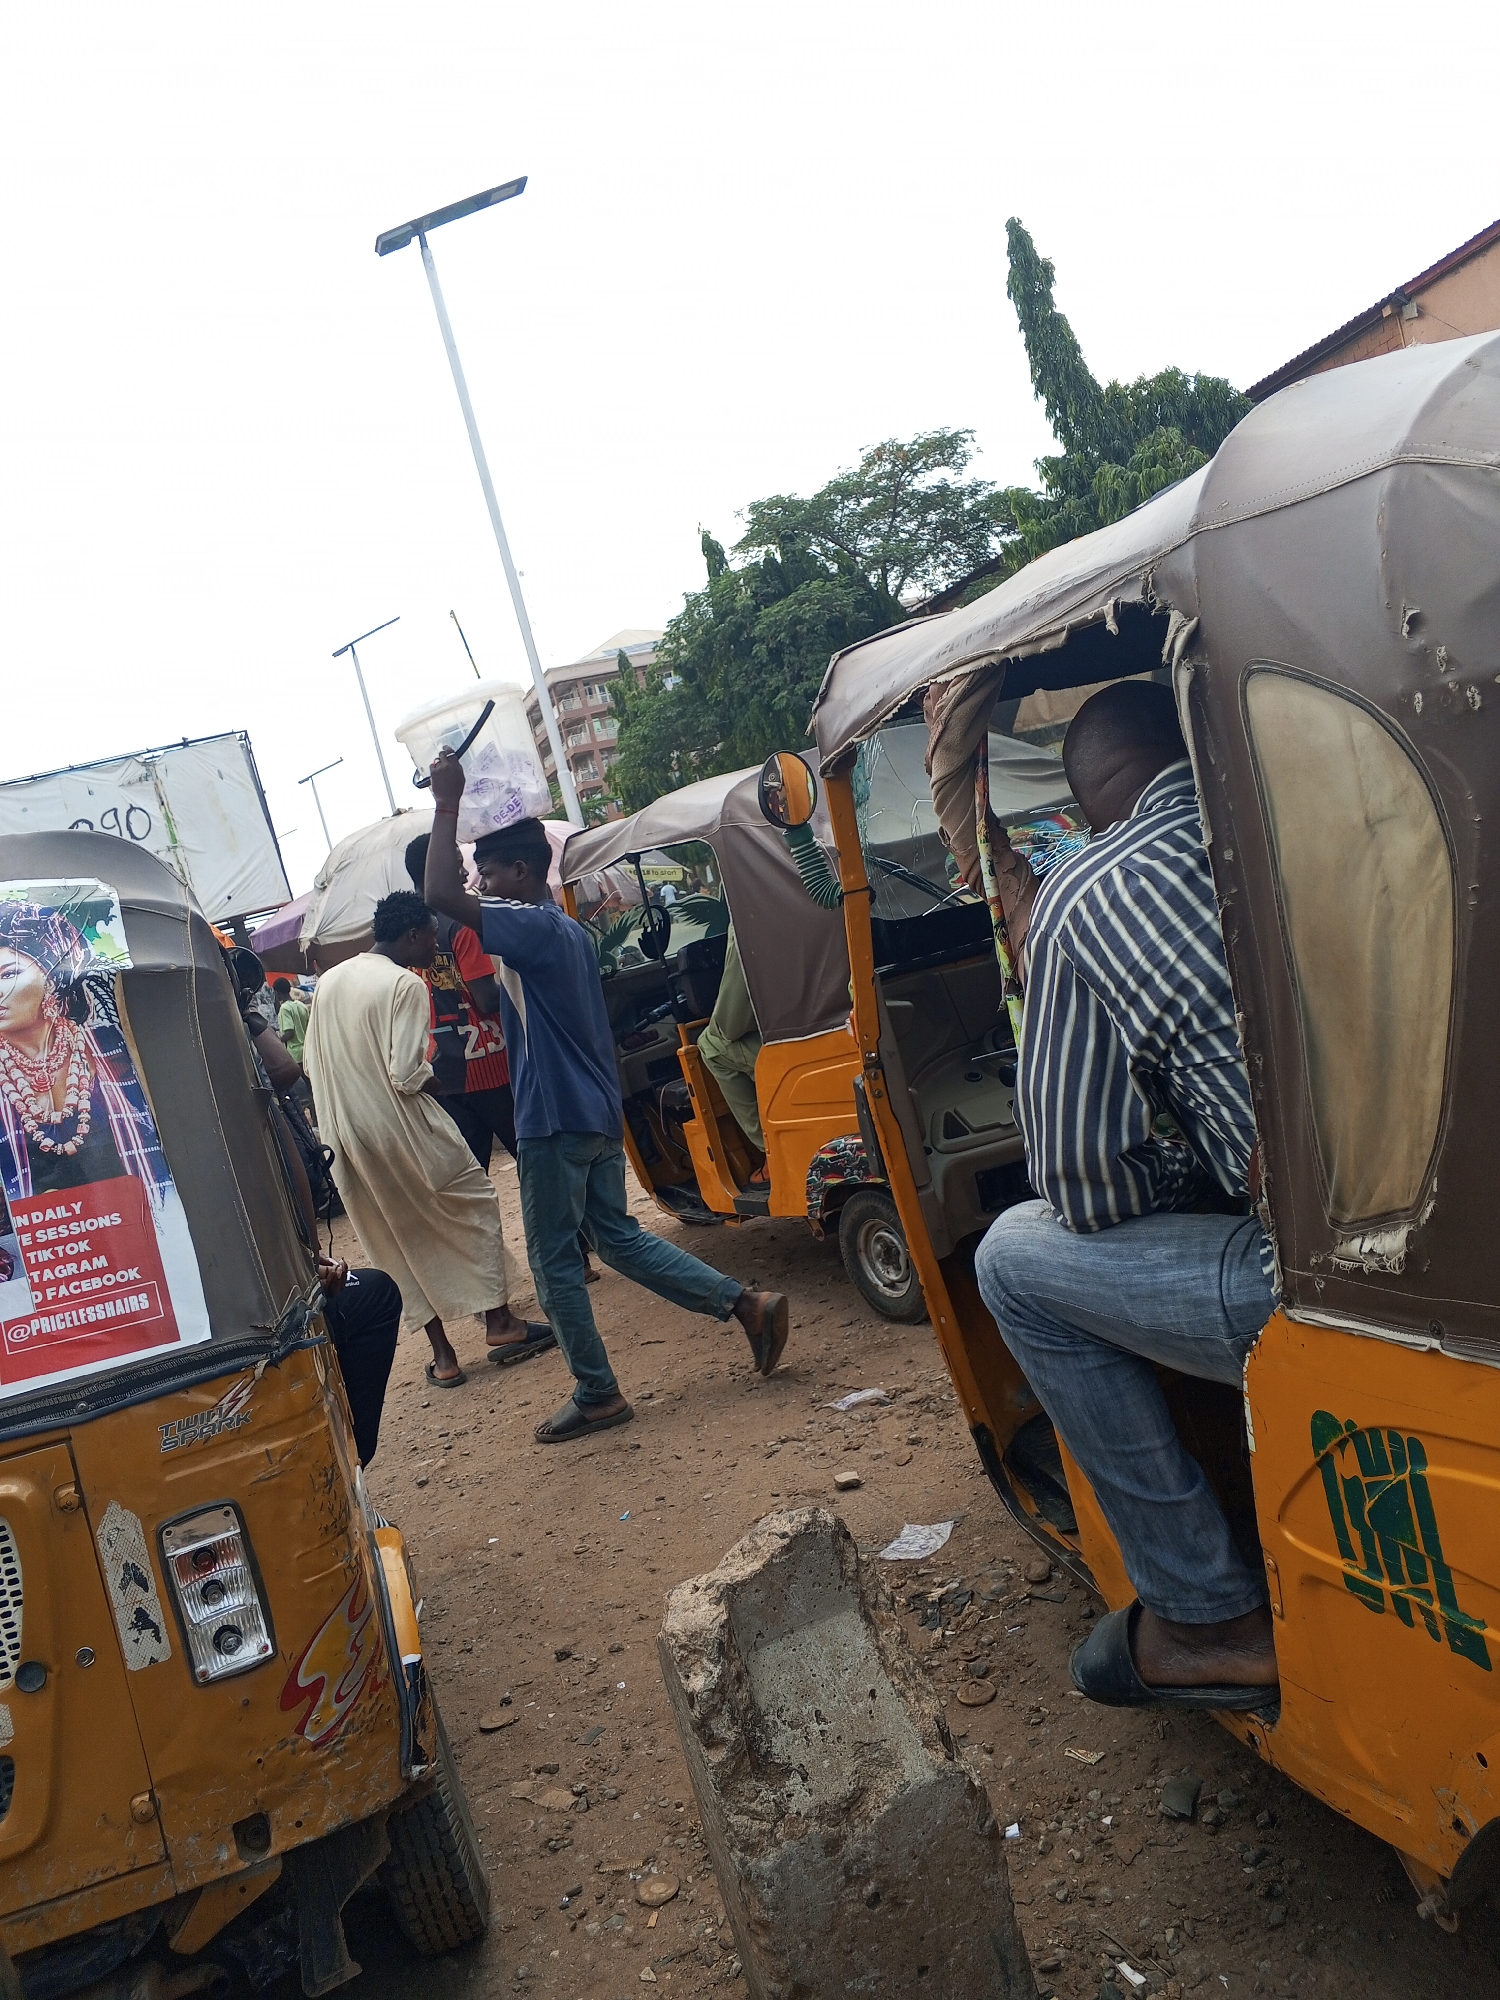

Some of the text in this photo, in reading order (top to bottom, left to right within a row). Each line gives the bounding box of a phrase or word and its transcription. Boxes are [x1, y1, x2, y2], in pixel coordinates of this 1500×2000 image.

[457, 1020, 506, 1060] 23
[17, 1212, 122, 1247] E SESSIONS
[31, 1201, 83, 1224] DAILY
[26, 1239, 92, 1265] TIKTOK
[27, 1255, 109, 1284] TAGRAM
[45, 1266, 142, 1301] FACEBOOK
[7, 1292, 150, 1343] @PRICELESSHAIRS
[158, 1405, 224, 1438] TWIN
[161, 1408, 253, 1453] SPARK
